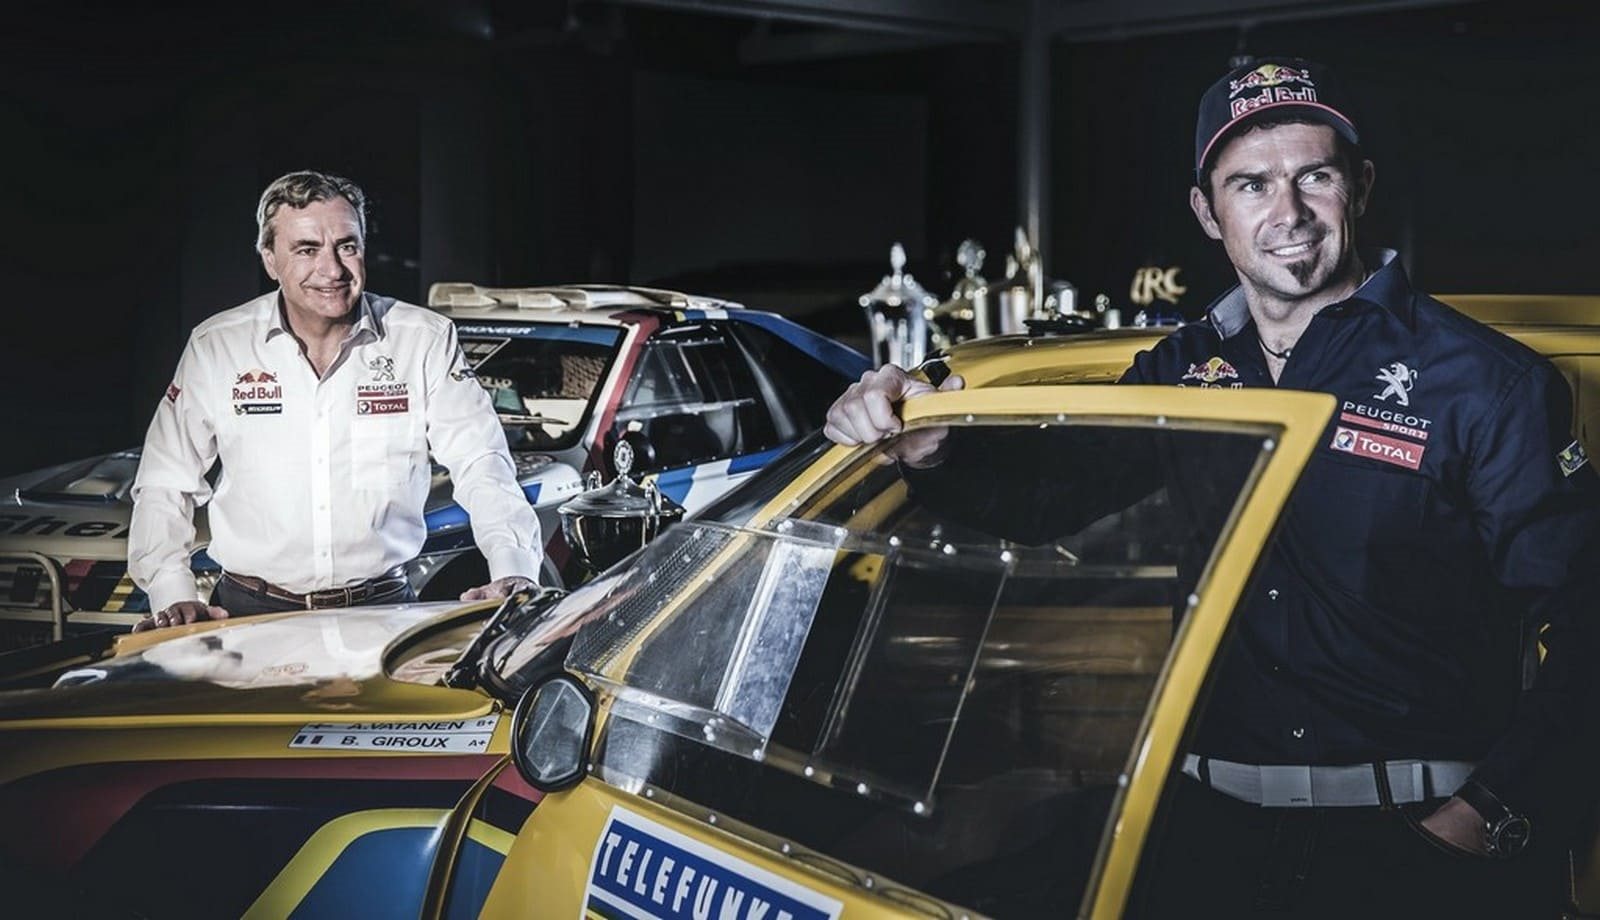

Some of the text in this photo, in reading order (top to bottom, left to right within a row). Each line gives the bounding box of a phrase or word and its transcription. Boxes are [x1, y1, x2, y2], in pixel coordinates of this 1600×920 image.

[1231, 86, 1317, 119] Red Bull
[232, 385, 282, 400] Red Bull
[357, 383, 408, 391] PEUGEOT
[1343, 401, 1432, 429] PEUGEOT
[1383, 422, 1428, 440] SPORT
[340, 735, 359, 746] B.
[371, 736, 450, 748] GIROUX
[599, 831, 794, 920] TELEFUNK
